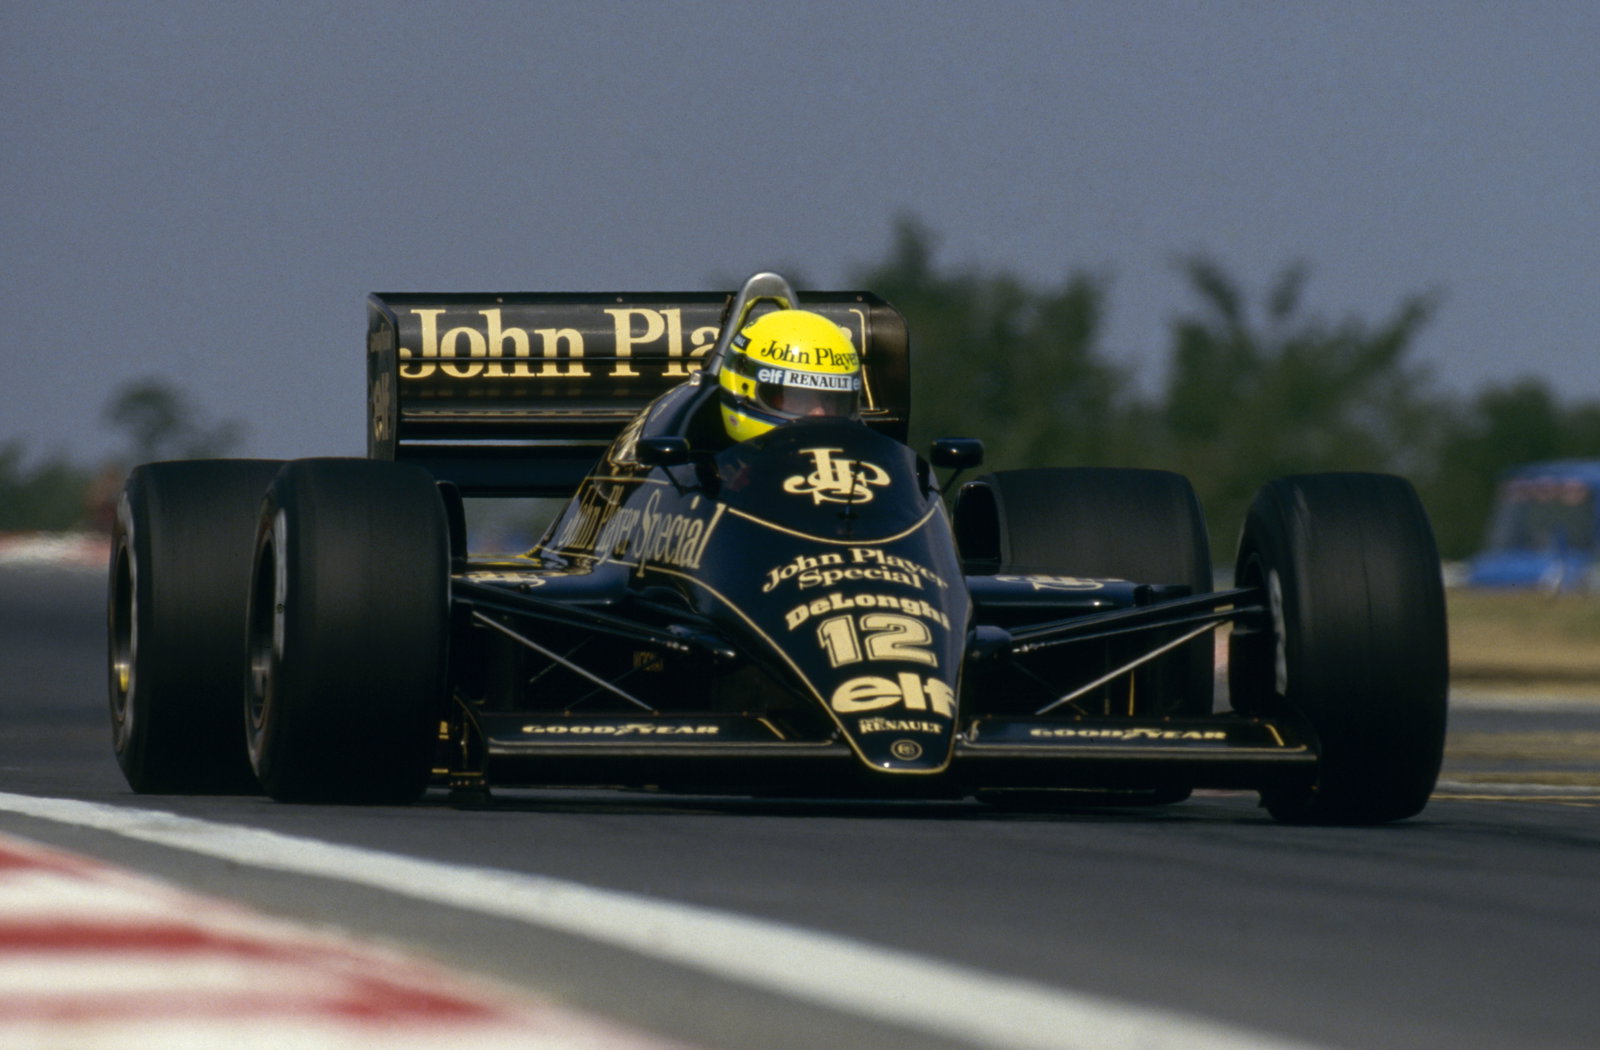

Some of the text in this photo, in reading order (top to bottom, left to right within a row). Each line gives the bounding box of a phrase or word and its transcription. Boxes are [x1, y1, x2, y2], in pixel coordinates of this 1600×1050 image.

[399, 308, 594, 378] John
[760, 339, 812, 366] John
[814, 347, 859, 371] Playe
[757, 368, 784, 385] elf
[789, 372, 850, 390] RENAULT
[630, 488, 728, 578] Special
[761, 547, 949, 593] John Player
[797, 565, 925, 591] Special
[816, 612, 939, 669] 12
[831, 672, 956, 719] elf
[521, 723, 720, 737] GOODYEAR
[858, 719, 944, 735] RENAULT
[1029, 727, 1228, 741] GOODYEAR
